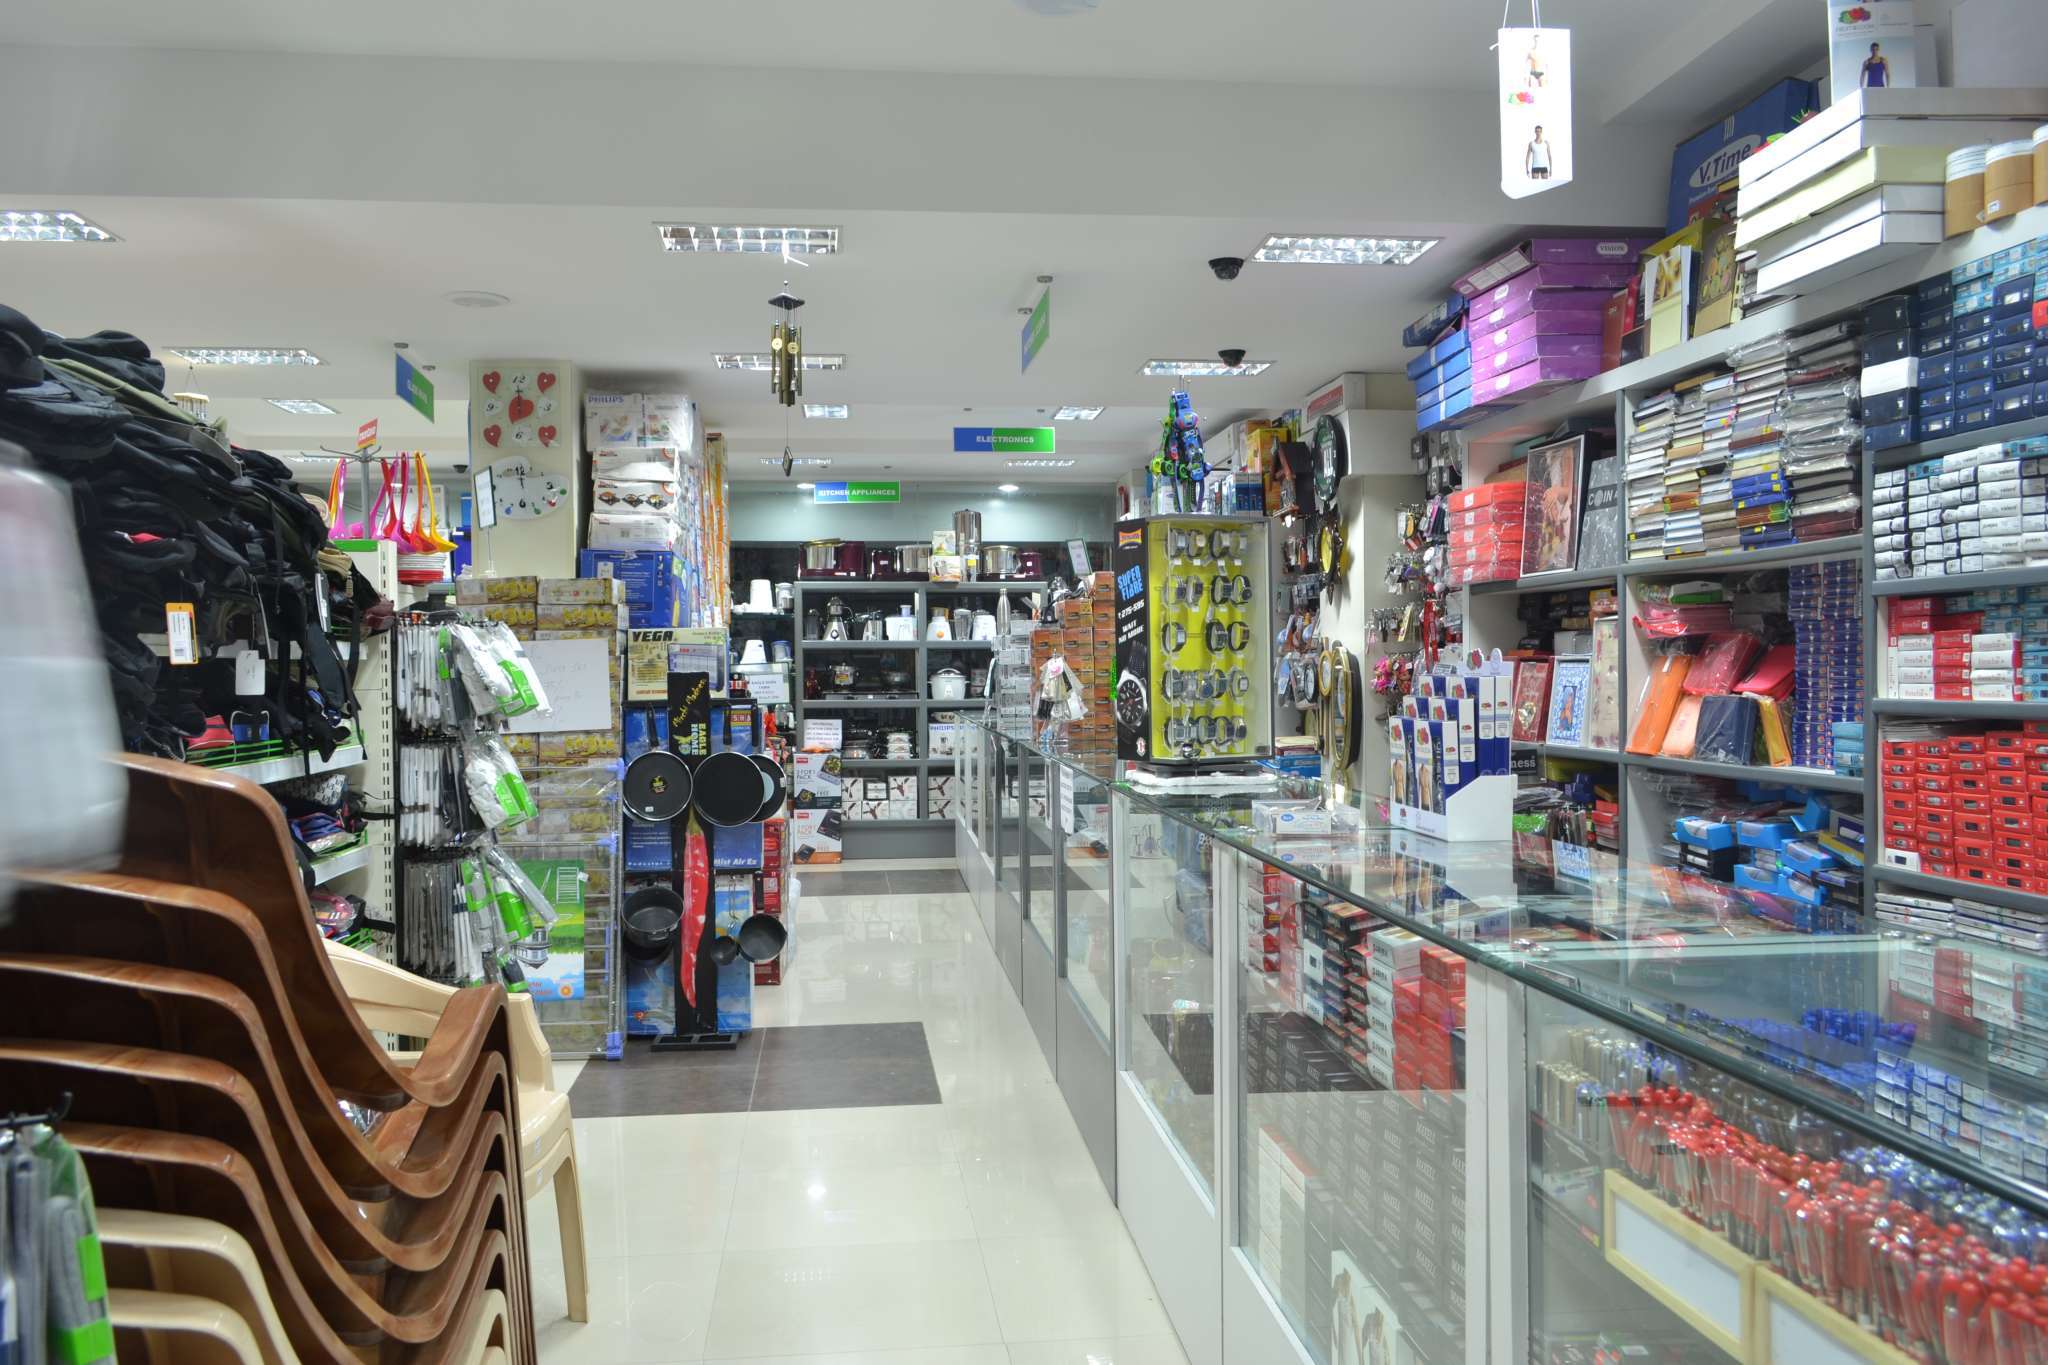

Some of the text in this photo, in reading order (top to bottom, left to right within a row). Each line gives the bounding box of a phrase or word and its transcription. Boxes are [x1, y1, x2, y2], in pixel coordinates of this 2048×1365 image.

[1699, 144, 1752, 185] V.Time
[512, 375, 526, 384] 12
[588, 395, 625, 404] PHILIPS
[515, 431, 524, 440] 6
[976, 435, 1035, 443] ELECTRONICS
[818, 489, 850, 497] KITCHEN
[1118, 565, 1141, 589] SUPER
[1121, 580, 1144, 600] FIBRE
[632, 631, 674, 642] VEGA
[691, 723, 699, 755] HOME
[699, 723, 708, 755] EAGLE
[1511, 757, 1536, 769] ness
